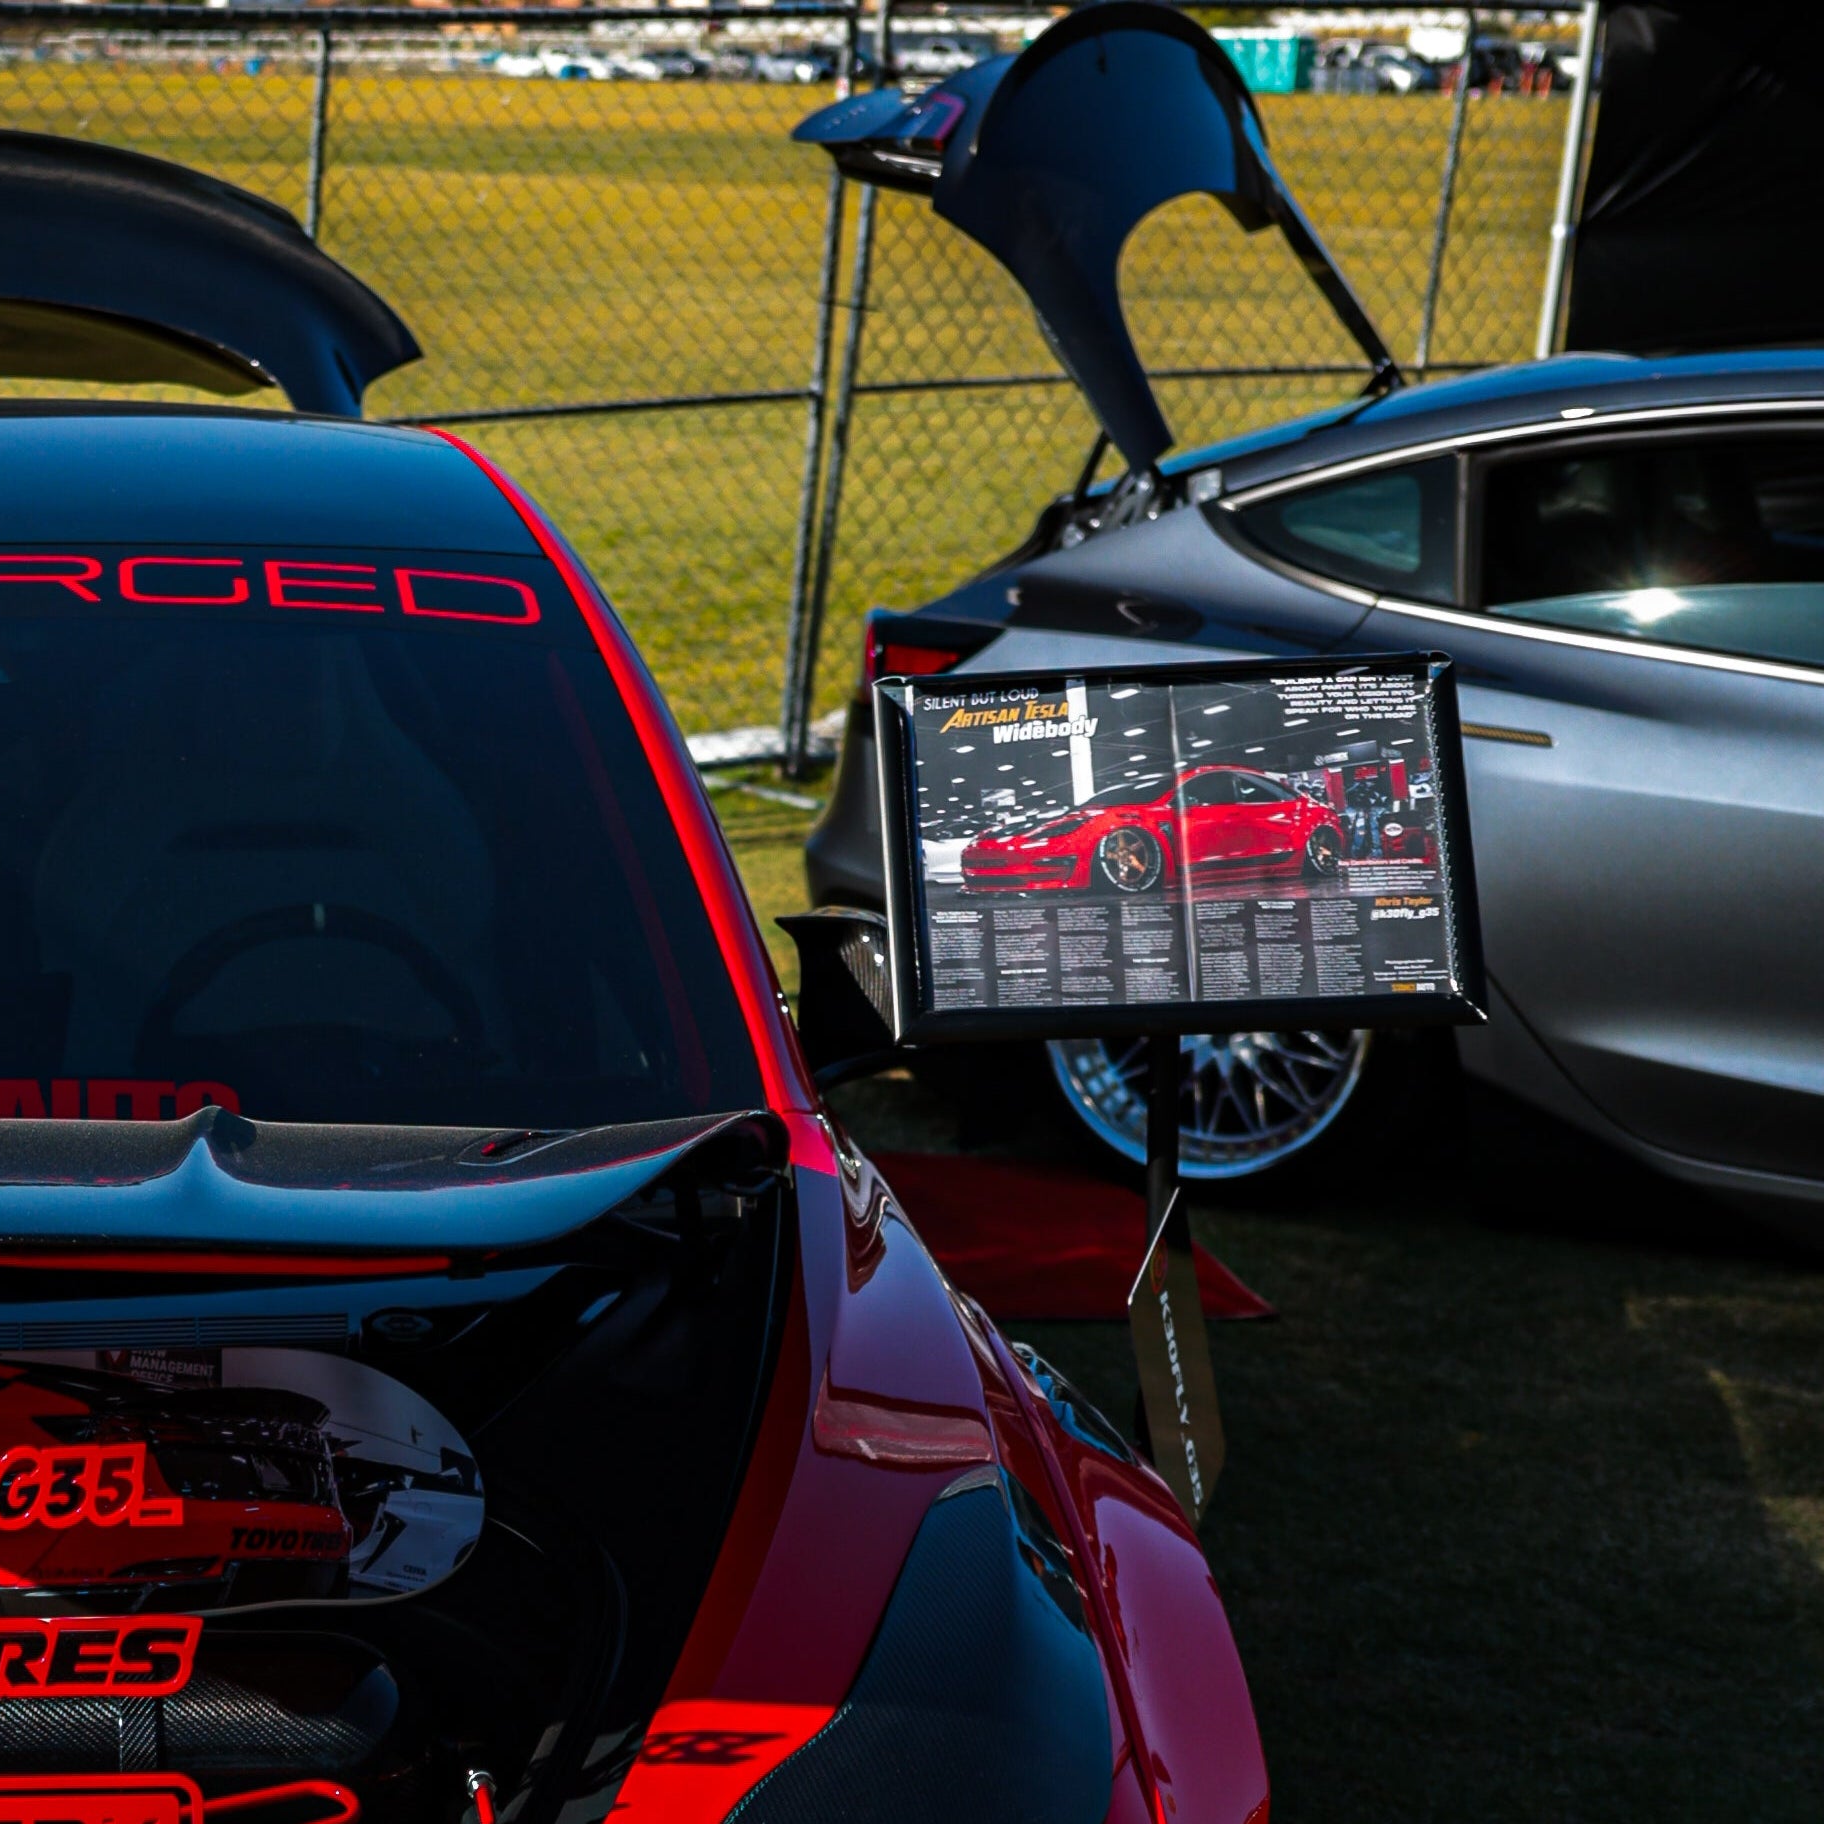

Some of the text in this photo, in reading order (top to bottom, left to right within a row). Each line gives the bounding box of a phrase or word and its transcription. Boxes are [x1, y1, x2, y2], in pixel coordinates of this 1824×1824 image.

[923, 687, 1039, 711] SILENT BUT LOUD
[993, 715, 1098, 744] Widebody
[129, 1356, 216, 1377] MANAGEMENT
[231, 1527, 300, 1550] TOYO
